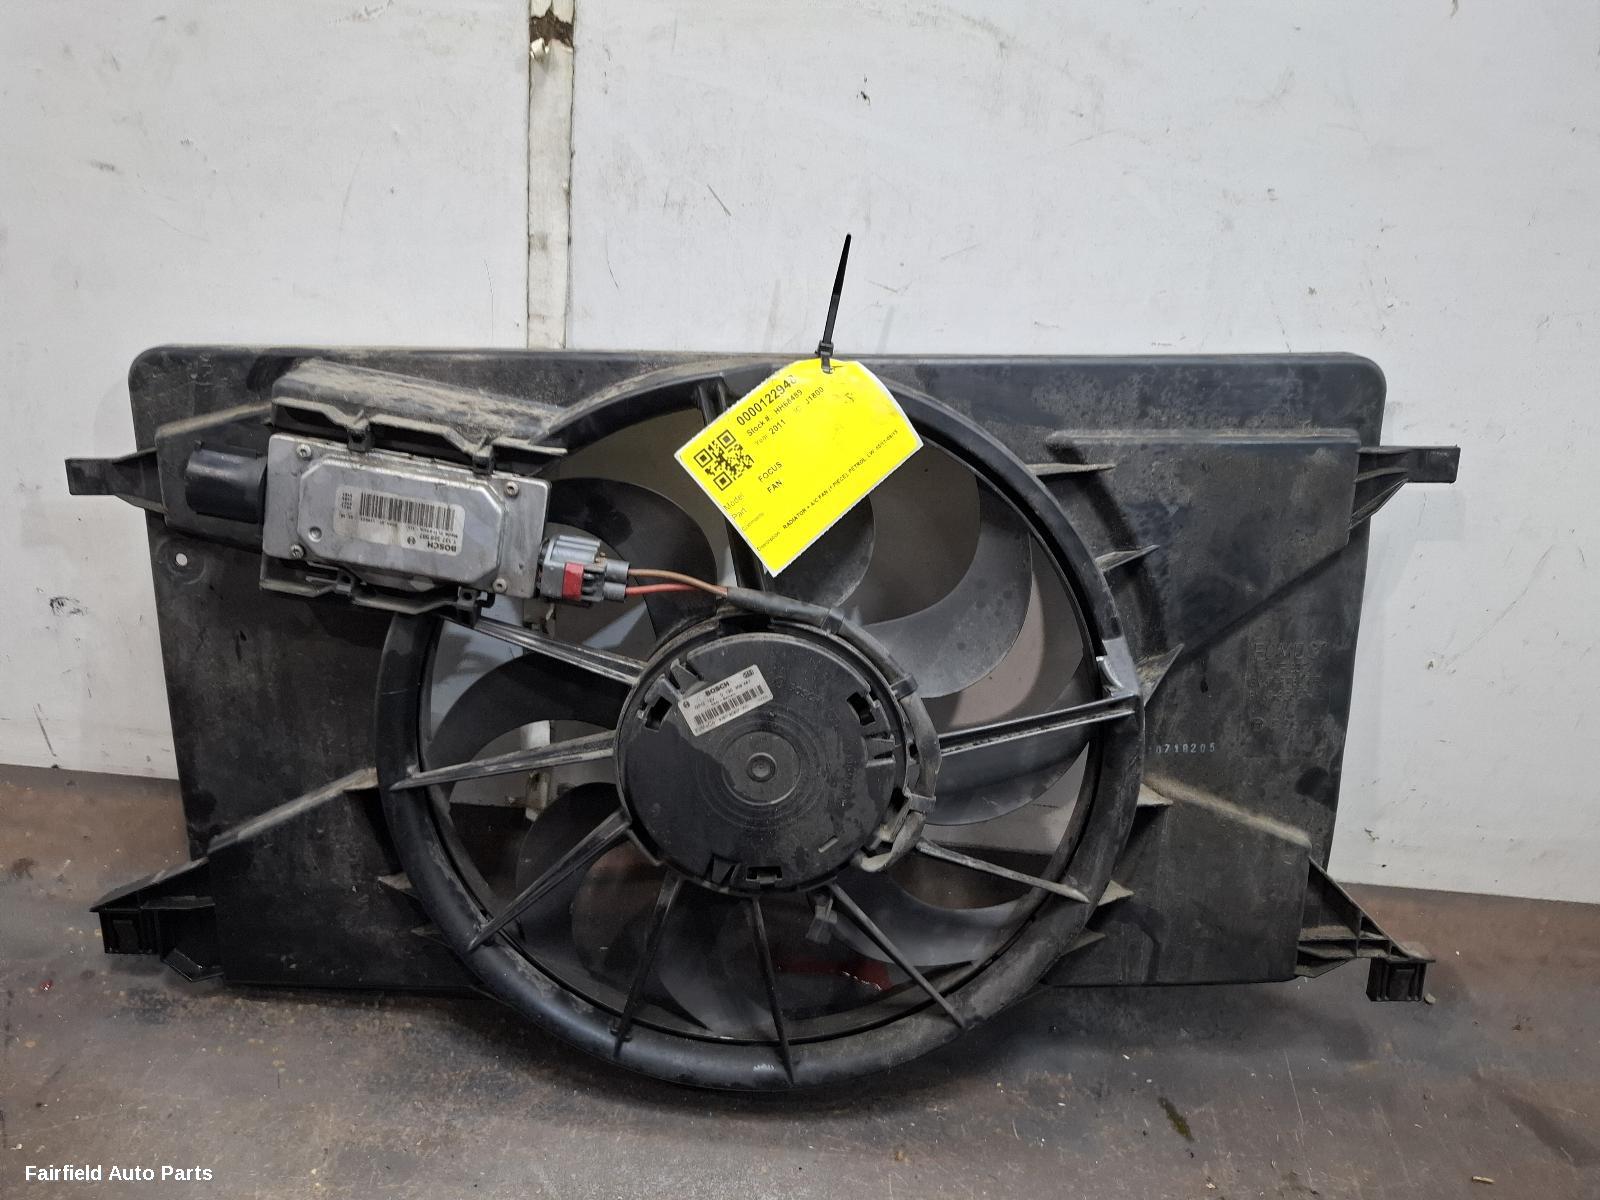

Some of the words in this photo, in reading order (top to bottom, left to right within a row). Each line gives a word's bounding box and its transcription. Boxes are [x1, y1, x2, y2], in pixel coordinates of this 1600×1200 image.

[746, 419, 765, 436] Stock
[768, 418, 786, 434] 2011
[757, 461, 782, 482] FOCUS
[766, 479, 782, 493] FAN
[782, 507, 807, 529] RADIATOR
[427, 541, 456, 552] BOSCH
[704, 680, 729, 696] BOSCH
